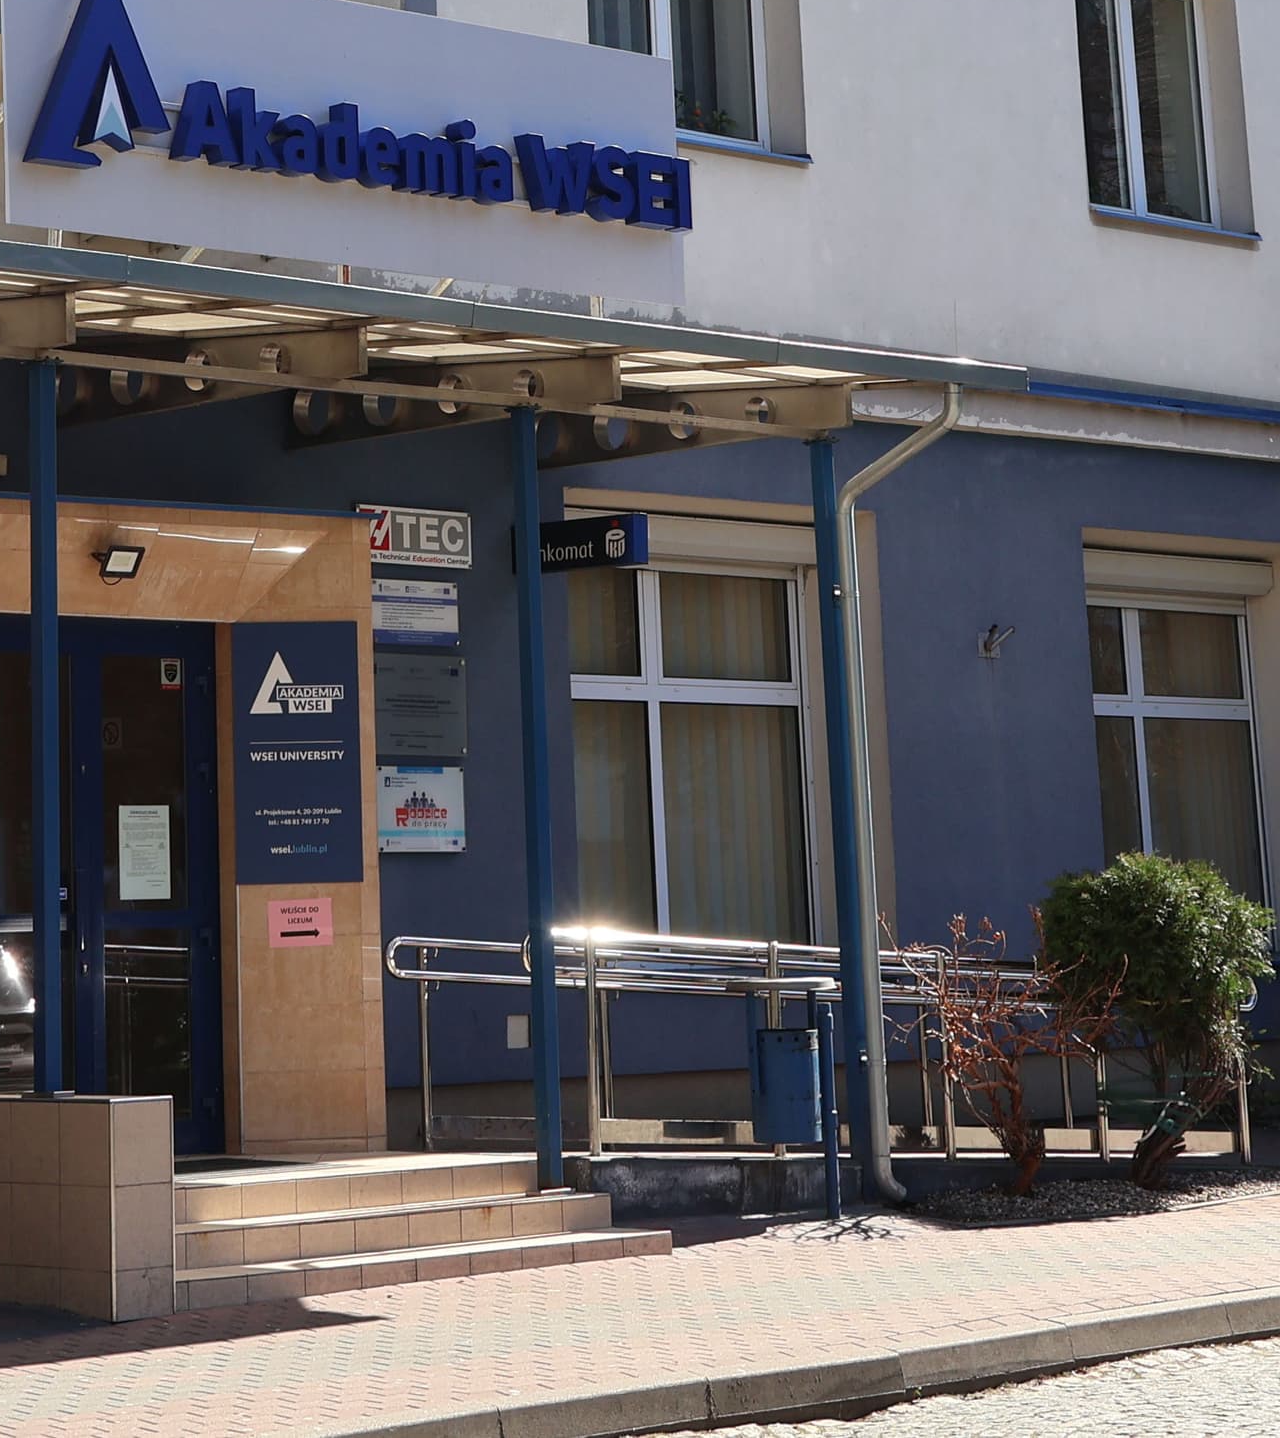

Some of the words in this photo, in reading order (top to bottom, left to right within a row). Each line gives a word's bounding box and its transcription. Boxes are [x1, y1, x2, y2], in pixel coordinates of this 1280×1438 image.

[169, 79, 514, 206] Akademia
[514, 132, 694, 232] WSEI
[539, 540, 594, 562] nkomat
[379, 552, 411, 561] Technical
[412, 554, 446, 564] Education
[446, 557, 470, 566] Center
[279, 687, 341, 698] AKADEMIA
[293, 700, 326, 711] WSEI
[250, 751, 277, 761] WSEI
[280, 750, 344, 761] UNIVERSITY
[263, 809, 296, 817] Projektowa
[424, 821, 448, 829] pracy
[270, 843, 328, 855] wsei.lublin.pl
[280, 906, 307, 915] WEJŚCIE
[287, 917, 313, 925] LICEUM
